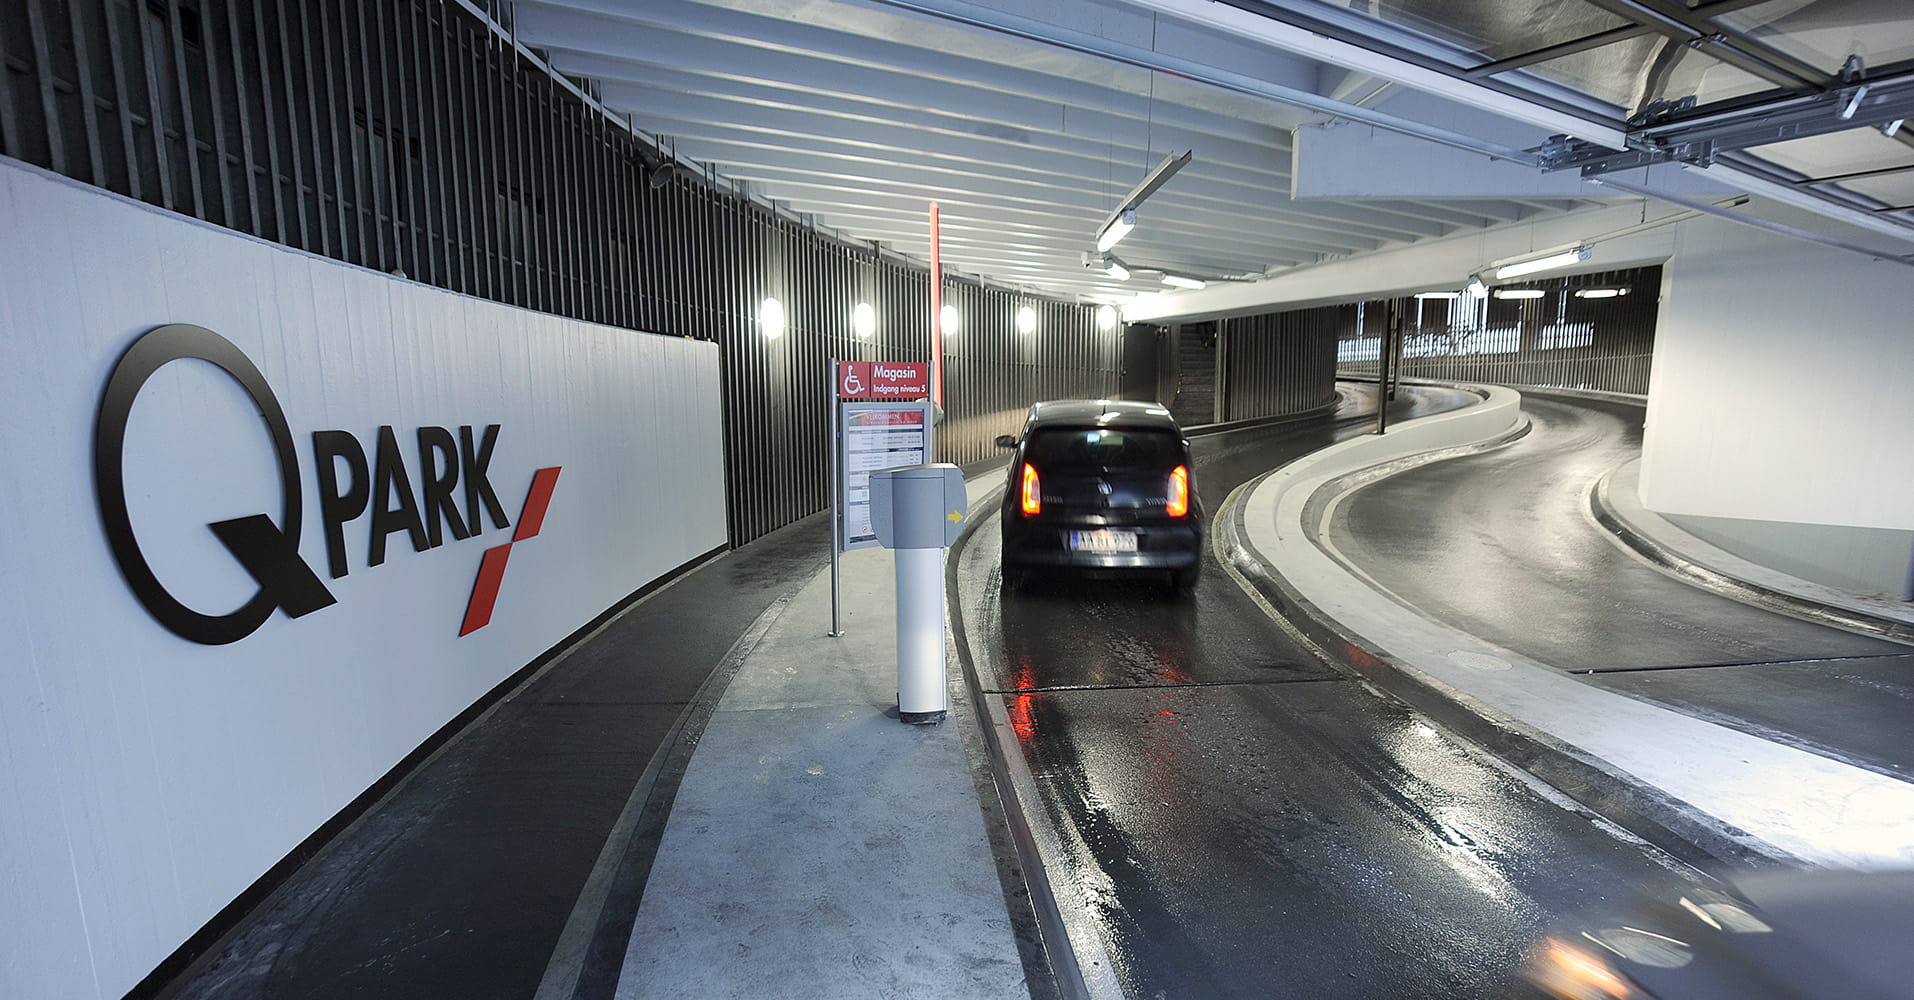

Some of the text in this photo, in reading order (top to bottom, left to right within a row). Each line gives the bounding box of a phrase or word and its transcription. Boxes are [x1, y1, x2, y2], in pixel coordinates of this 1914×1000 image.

[873, 365, 917, 381] Magasin
[873, 384, 926, 394] Indgang niveau 5
[314, 424, 510, 579] PARK
